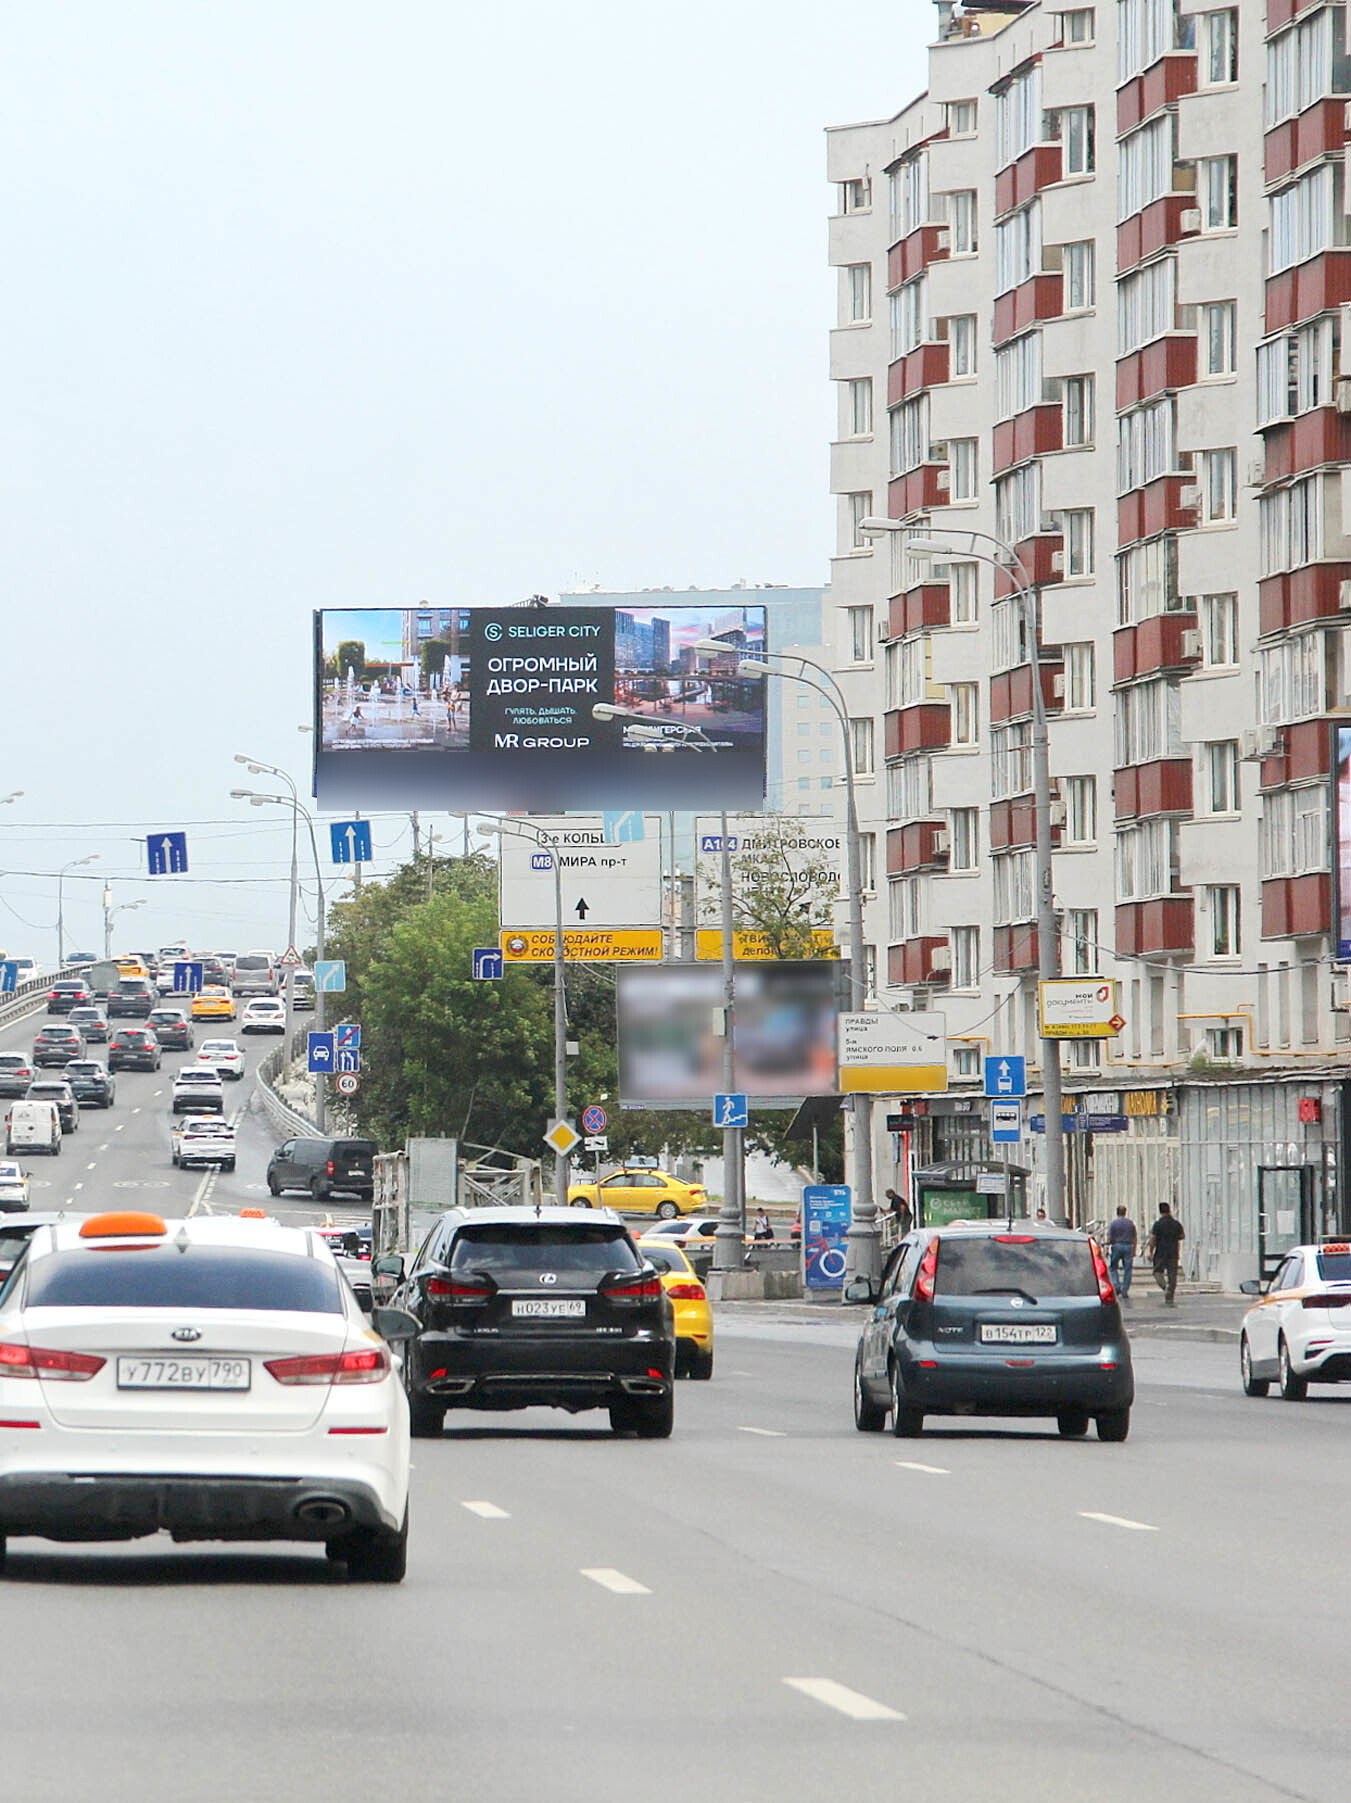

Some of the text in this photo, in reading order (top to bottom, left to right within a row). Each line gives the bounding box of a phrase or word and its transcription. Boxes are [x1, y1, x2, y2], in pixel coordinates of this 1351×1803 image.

[508, 625, 601, 638] SELIGER CITY
[488, 653, 597, 672] ОГРОМНЫЙ
[486, 678, 598, 695] ДВОР-ПАРК
[494, 733, 590, 748] MR GROUP
[559, 856, 597, 867] МИРА
[601, 858, 628, 869] пр-т
[531, 934, 613, 944] СОБЮДАЙТЕ
[531, 946, 658, 957] СКООСТНОЙ РЕЖИМ!
[341, 1080, 354, 1088] 60
[212, 1361, 242, 1378] 790
